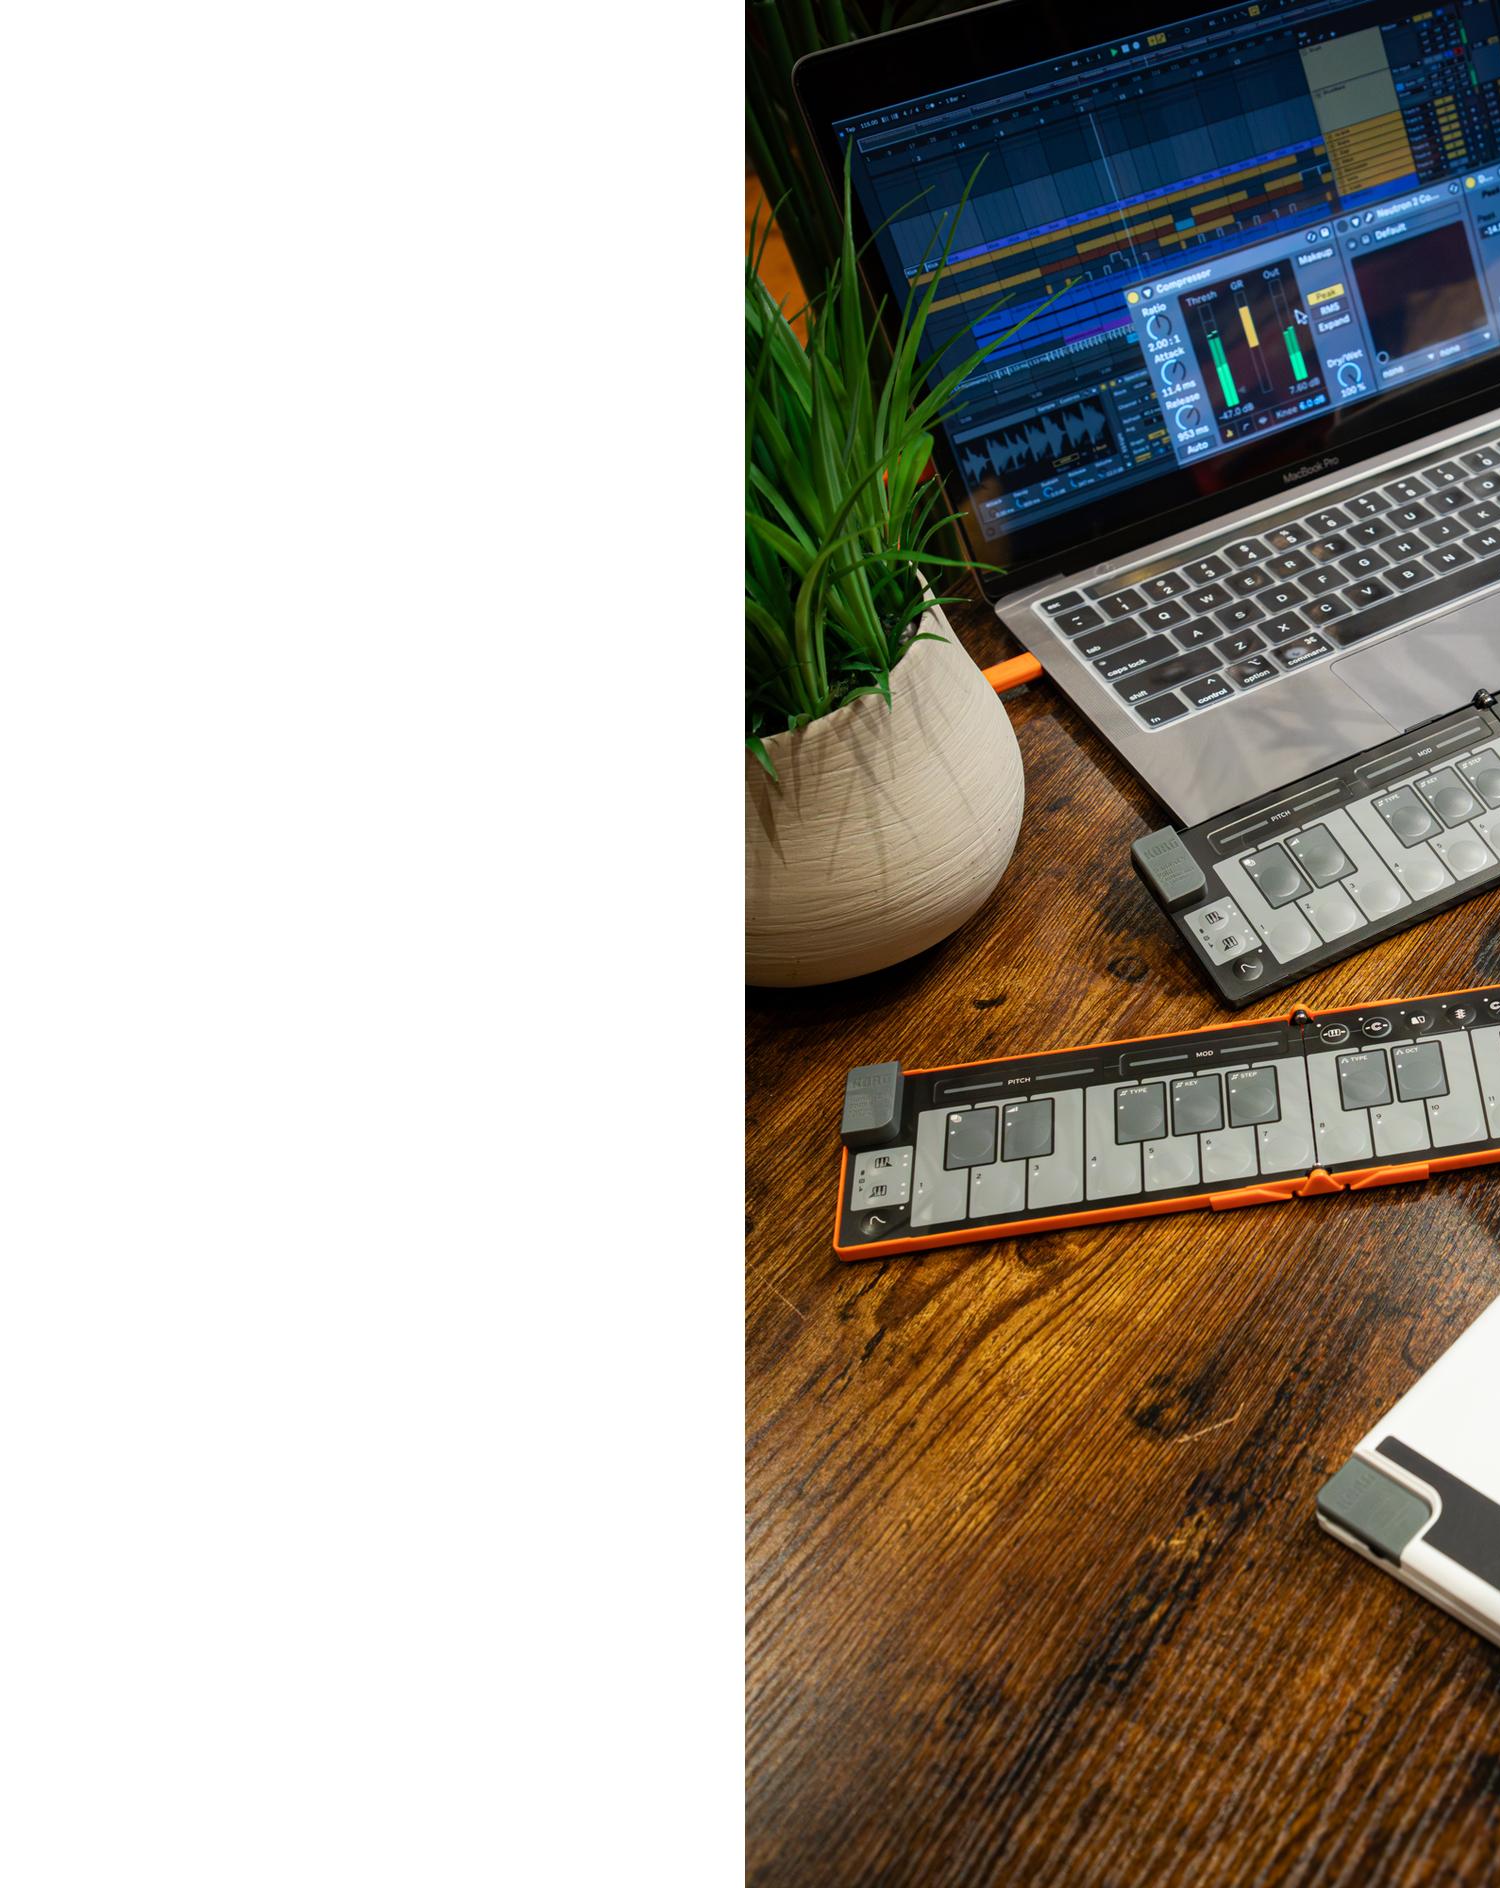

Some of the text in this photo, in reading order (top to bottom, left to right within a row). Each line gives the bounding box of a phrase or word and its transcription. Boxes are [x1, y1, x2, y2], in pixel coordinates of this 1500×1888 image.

[1376, 200, 1412, 218] Neutron
[1375, 223, 1407, 240] Default
[1298, 248, 1334, 266] Makeup
[1263, 268, 1281, 279] Out
[1156, 269, 1212, 294] Compressor
[1230, 280, 1245, 291] GR
[1186, 291, 1218, 306] Thresh
[1315, 290, 1336, 301] Peak
[1141, 303, 1167, 317] Ratio
[1320, 302, 1341, 316] RMS
[1318, 314, 1351, 333] Expand
[1154, 347, 1186, 364] Attack
[1439, 344, 1461, 357] none
[1326, 349, 1363, 368] Dry/Wet
[1382, 366, 1404, 379] none
[1182, 380, 1197, 390] ms
[1165, 393, 1201, 410] Release
[1177, 425, 1210, 442] 953 ms
[1187, 442, 1209, 455] Auto
[1282, 457, 1340, 484] MacBook Pro
[1482, 481, 1494, 489] O
[1366, 504, 1376, 512] 7
[1404, 512, 1416, 521] U
[1477, 510, 1490, 519] K
[1364, 527, 1375, 535] Y
[1482, 536, 1496, 546] M
[1325, 543, 1335, 551] T
[1398, 543, 1411, 551] H
[1248, 552, 1258, 560] 4
[1442, 554, 1455, 563] N
[1284, 560, 1296, 568] R
[1358, 558, 1370, 567] G
[1206, 570, 1216, 578] 3
[1402, 570, 1414, 579] B
[1244, 577, 1255, 586] E
[1317, 575, 1329, 584] F
[1163, 586, 1173, 594] 2
[1360, 587, 1372, 595] V
[1200, 594, 1214, 604] W
[1276, 594, 1288, 602] D
[1320, 604, 1332, 612] C
[1158, 612, 1171, 621] Q
[1235, 611, 1245, 619] S
[1277, 623, 1290, 632] X
[1192, 628, 1203, 638] A
[1086, 644, 1101, 654] tab
[1234, 641, 1247, 650] Z
[1288, 646, 1328, 667] command
[1107, 658, 1147, 677] caps lock
[1243, 668, 1270, 684] option
[1128, 690, 1148, 701] shift
[1198, 687, 1228, 705] control
[1150, 715, 1161, 724] fn
[1417, 747, 1433, 758] MOD
[1384, 793, 1400, 804] TYPE
[1270, 810, 1292, 823] PITCH
[1195, 1050, 1214, 1058] MOD
[1350, 1055, 1368, 1063] TYPE
[1240, 1071, 1258, 1079] STEP
[1007, 1076, 1031, 1086] PITCH
[1184, 1079, 1199, 1087] KEY
[1129, 1087, 1148, 1095] TYPE
